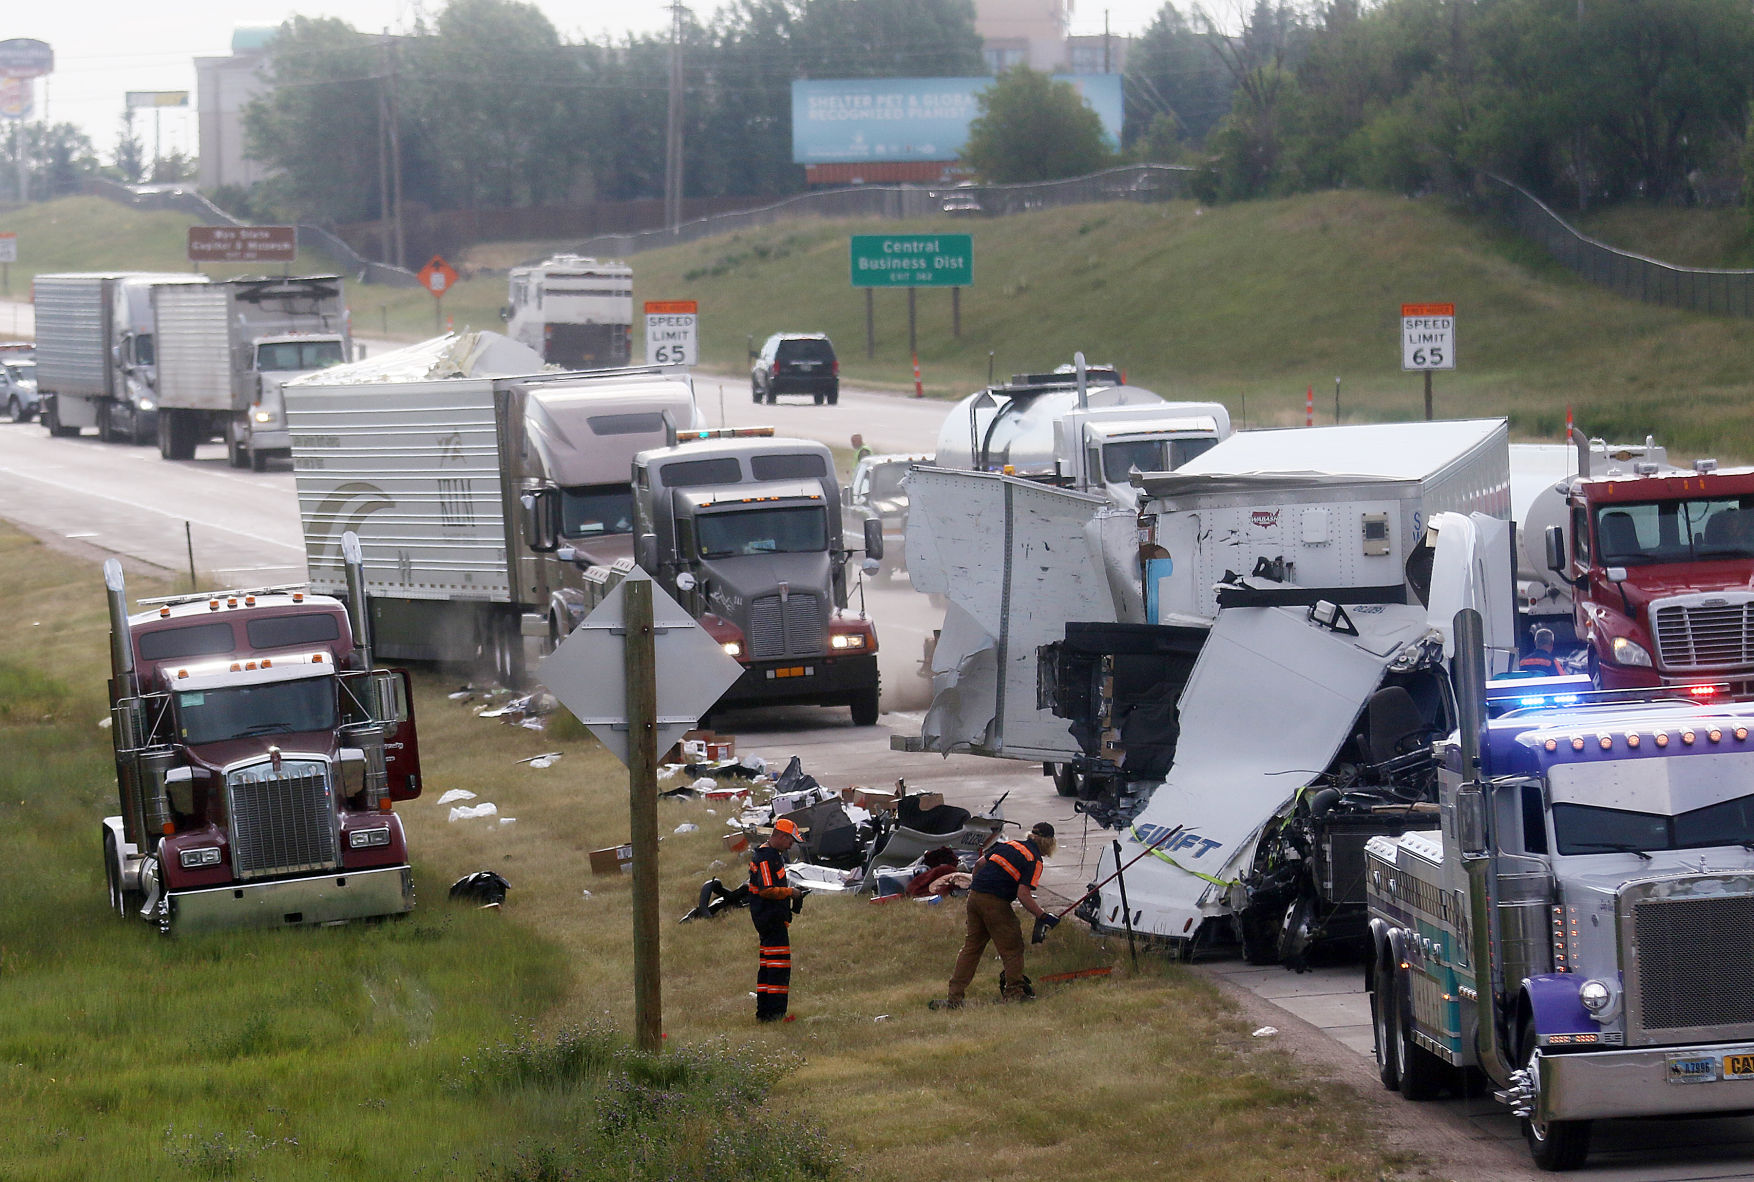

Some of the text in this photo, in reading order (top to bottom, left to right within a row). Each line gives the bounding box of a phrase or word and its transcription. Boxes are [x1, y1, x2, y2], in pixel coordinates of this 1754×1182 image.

[883, 240, 940, 254] Central
[859, 256, 964, 270] Business Dist
[649, 316, 694, 327] SPEED
[1405, 319, 1450, 330] SPEED
[652, 331, 689, 341] LIMIT
[1409, 334, 1444, 344] LIMIT
[655, 345, 686, 363] 65
[1413, 347, 1444, 366] 65
[1127, 823, 1223, 859] SWIFT
